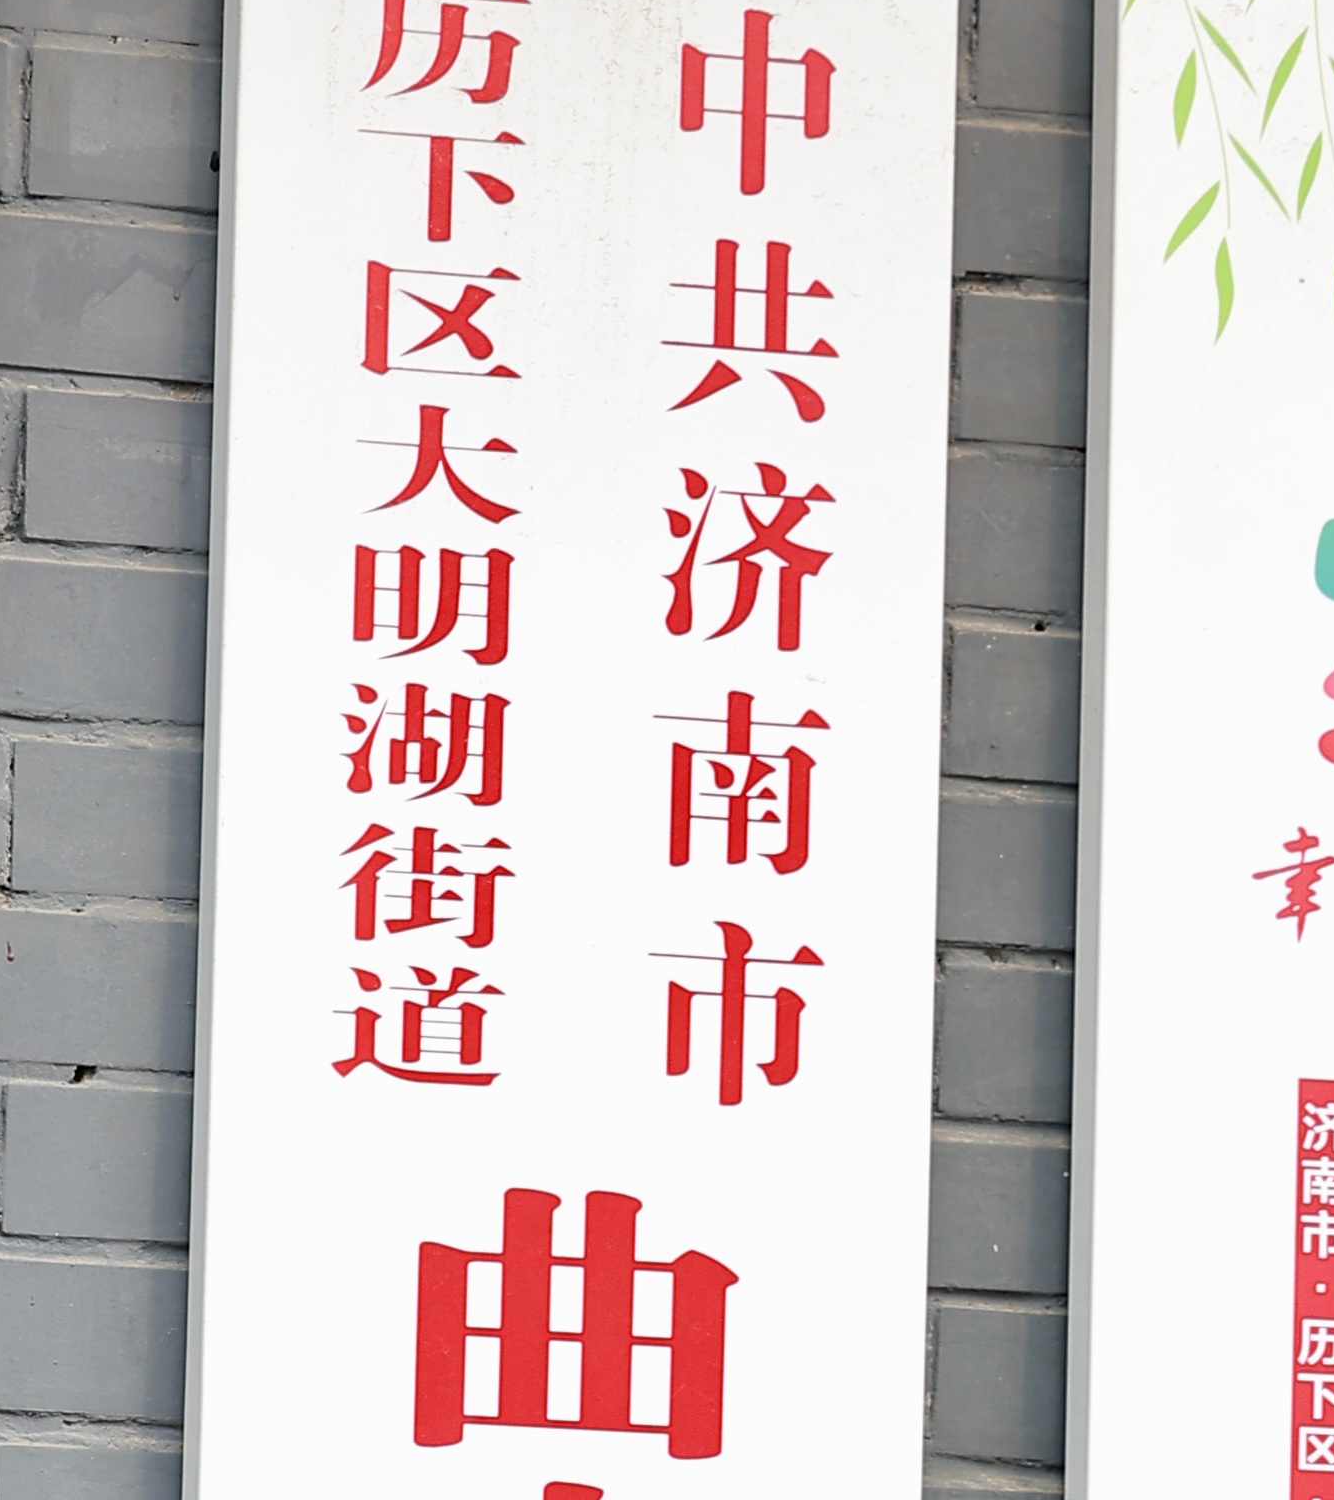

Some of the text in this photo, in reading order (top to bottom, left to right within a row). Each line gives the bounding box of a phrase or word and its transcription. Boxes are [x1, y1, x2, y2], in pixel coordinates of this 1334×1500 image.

[648, 9, 839, 1106] 中共济南市
